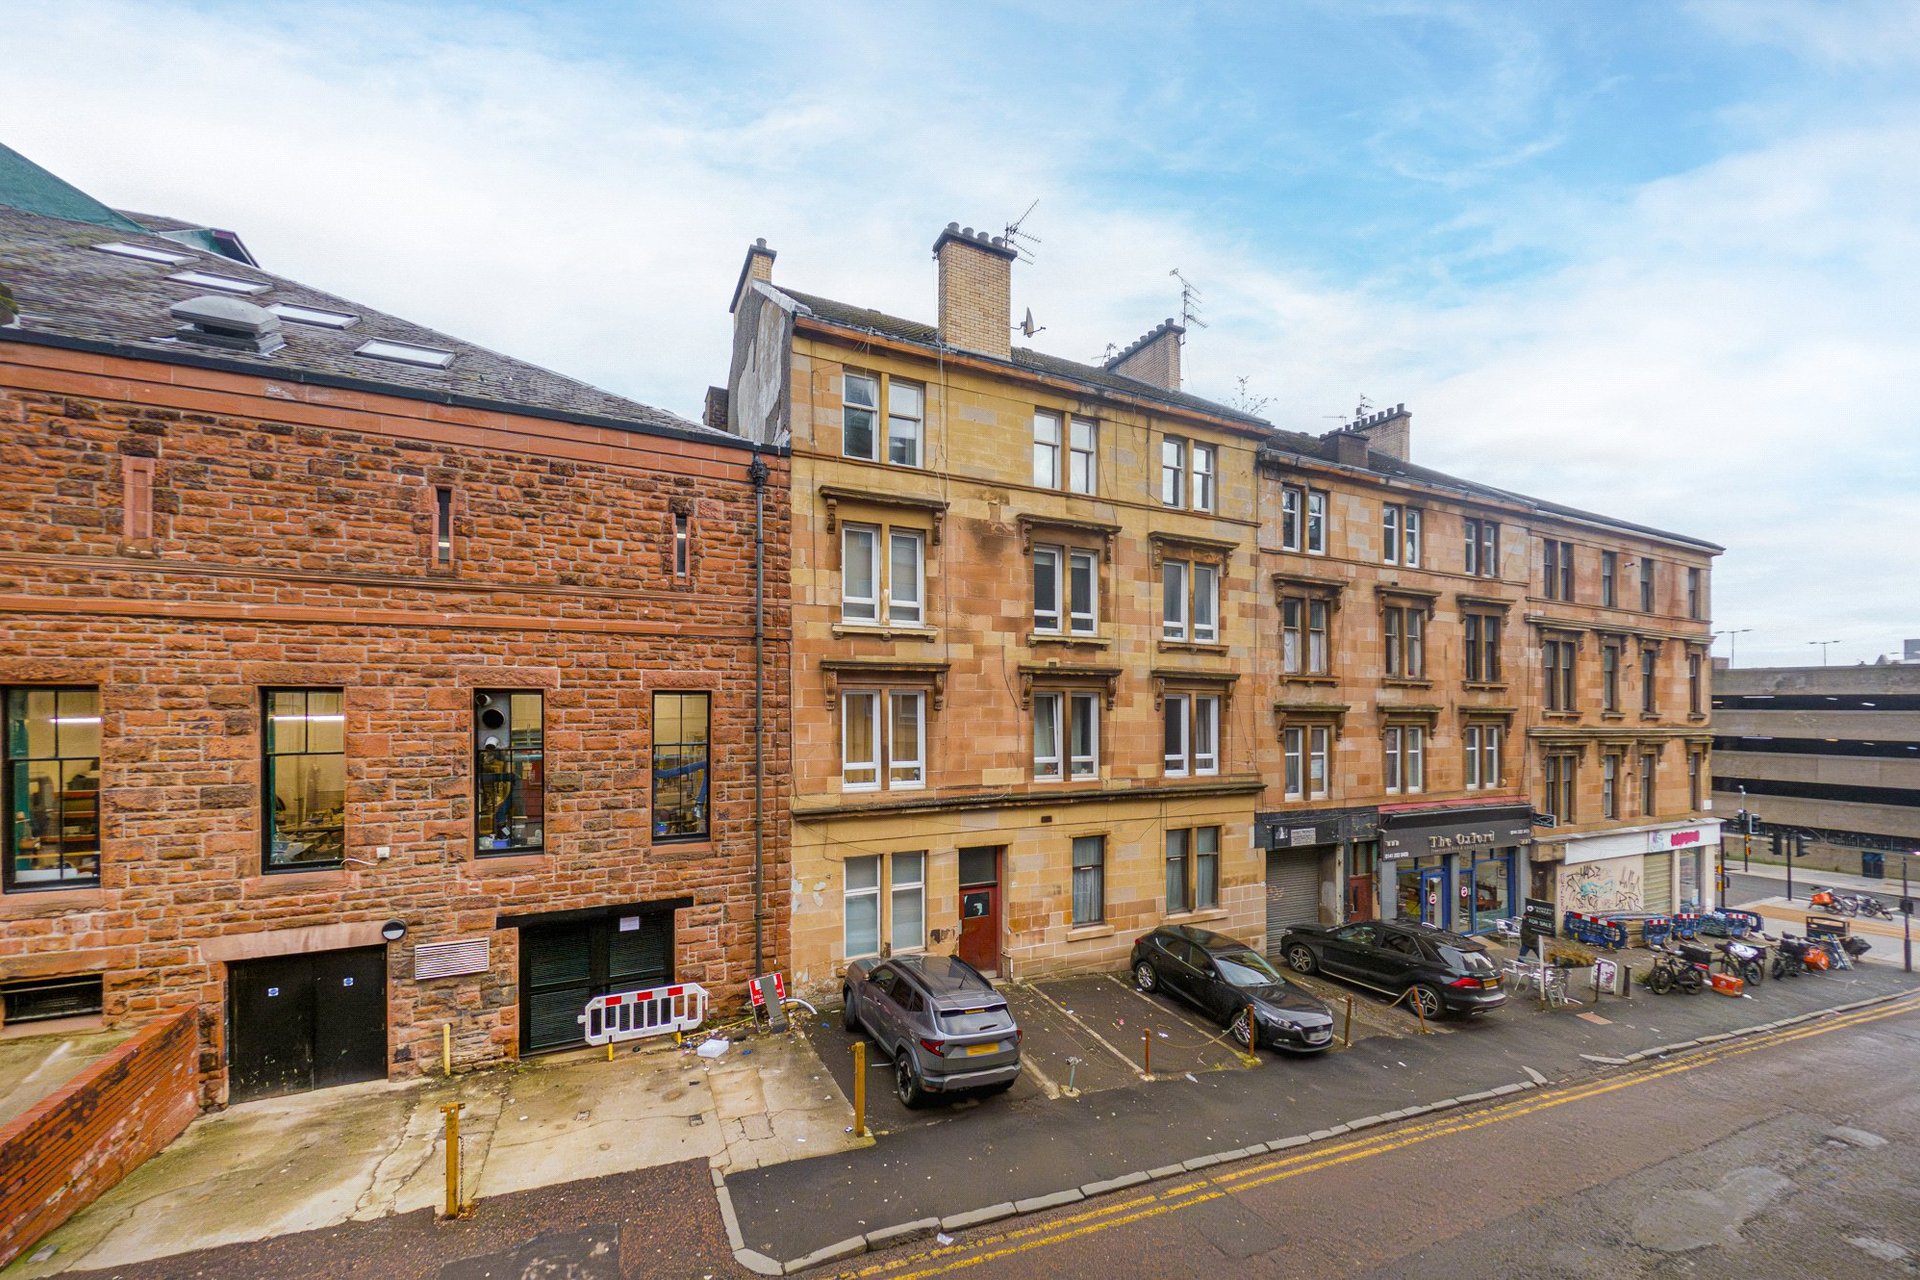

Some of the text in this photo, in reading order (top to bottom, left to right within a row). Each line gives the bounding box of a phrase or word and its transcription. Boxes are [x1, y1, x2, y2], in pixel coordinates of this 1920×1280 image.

[1428, 835, 1452, 848] The
[1456, 830, 1495, 845] Oxford
[1539, 920, 1552, 929] SALE
